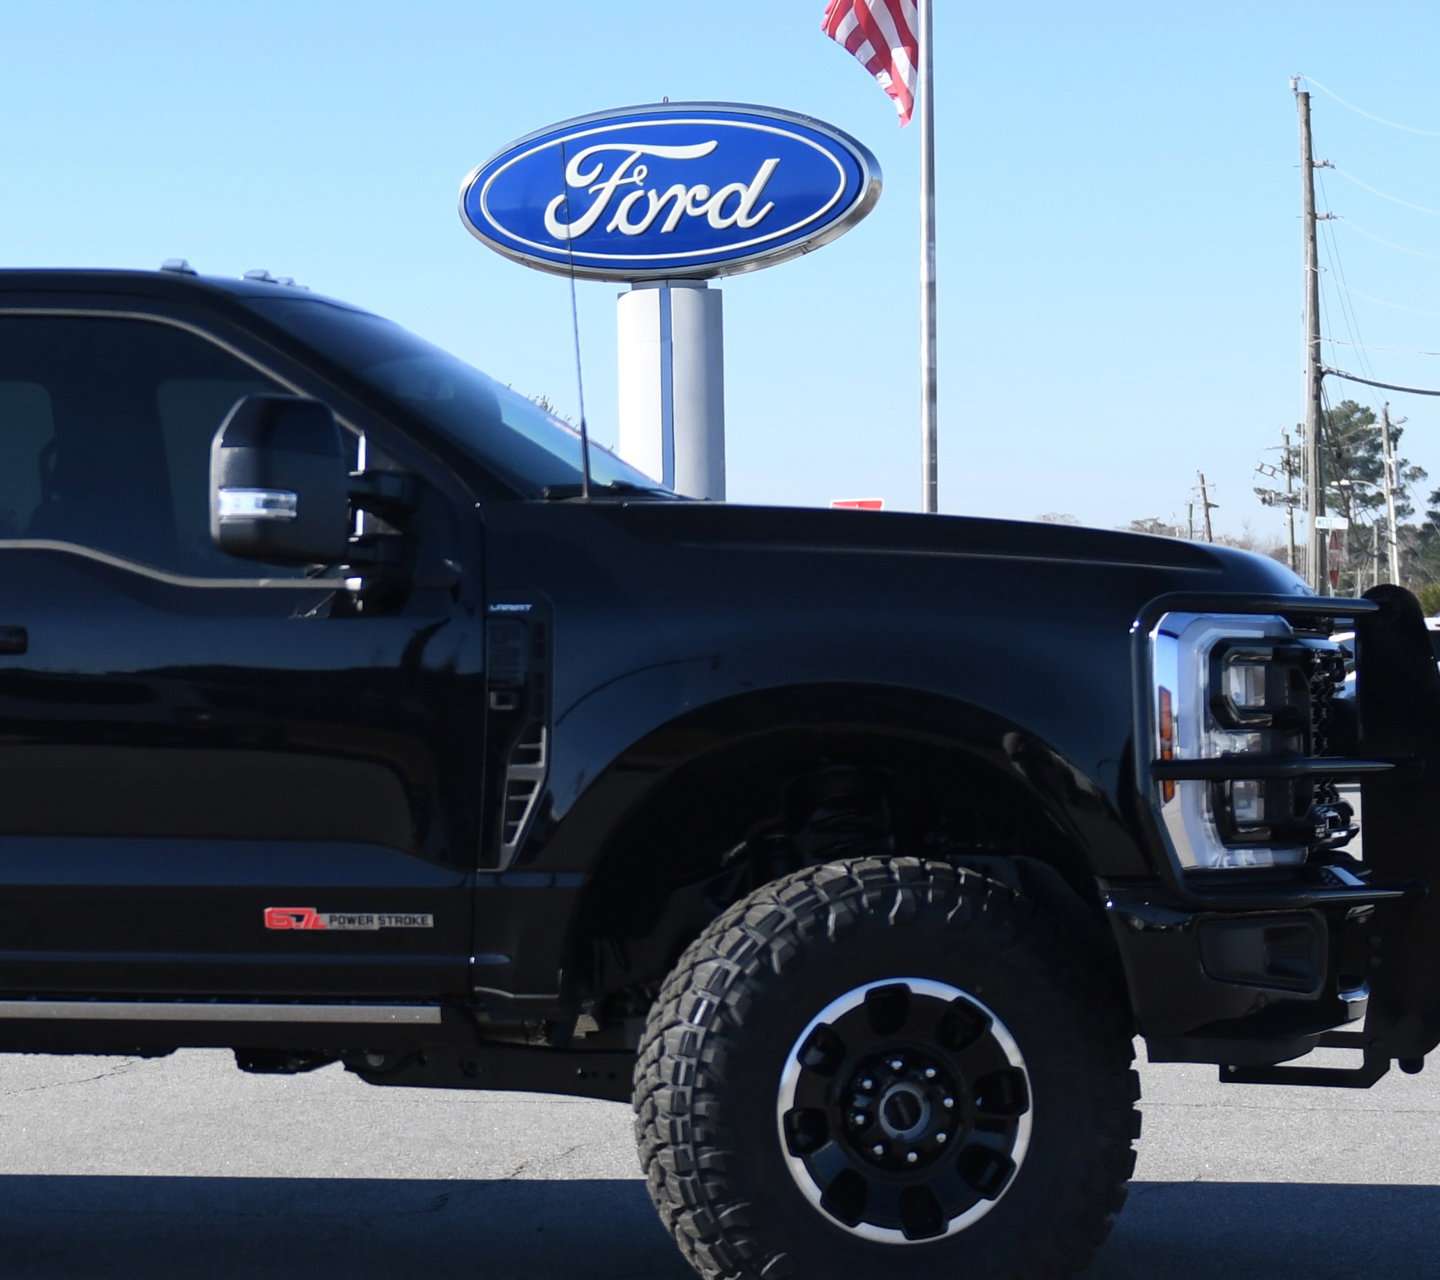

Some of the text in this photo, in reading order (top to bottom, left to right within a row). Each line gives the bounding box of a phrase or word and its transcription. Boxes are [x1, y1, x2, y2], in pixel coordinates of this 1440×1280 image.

[544, 139, 781, 241] Ford
[329, 914, 374, 927] POWER
[378, 914, 430, 927] STROKE
